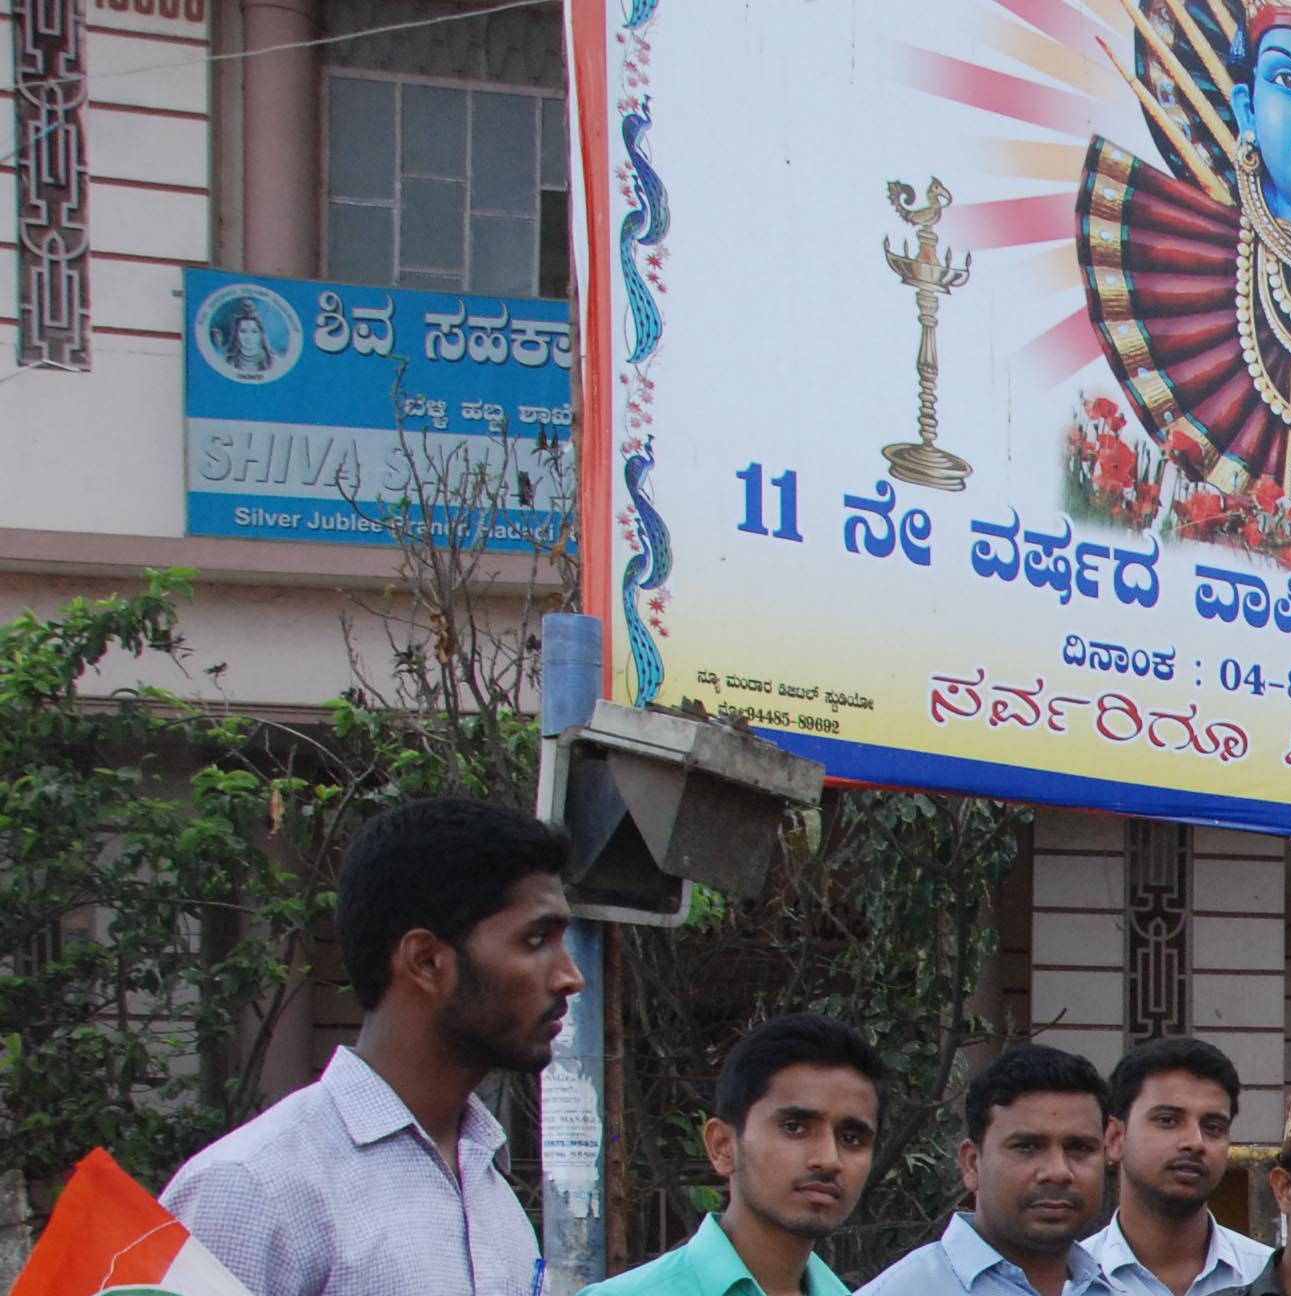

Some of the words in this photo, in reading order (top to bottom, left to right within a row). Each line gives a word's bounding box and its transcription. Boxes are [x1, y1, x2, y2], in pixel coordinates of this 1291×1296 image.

[314, 291, 395, 356] ಶಿವ
[200, 431, 361, 488] SHIVA
[235, 506, 302, 530] Silver
[307, 510, 382, 534] Jublee
[736, 463, 803, 541] 11
[844, 478, 932, 566] ನೇ
[972, 505, 1159, 608] ವರ್ಷದ
[1063, 633, 1176, 681] ದಿನಾಂಕ
[930, 667, 1248, 762] ಸರ್ವರಿಗೂ
